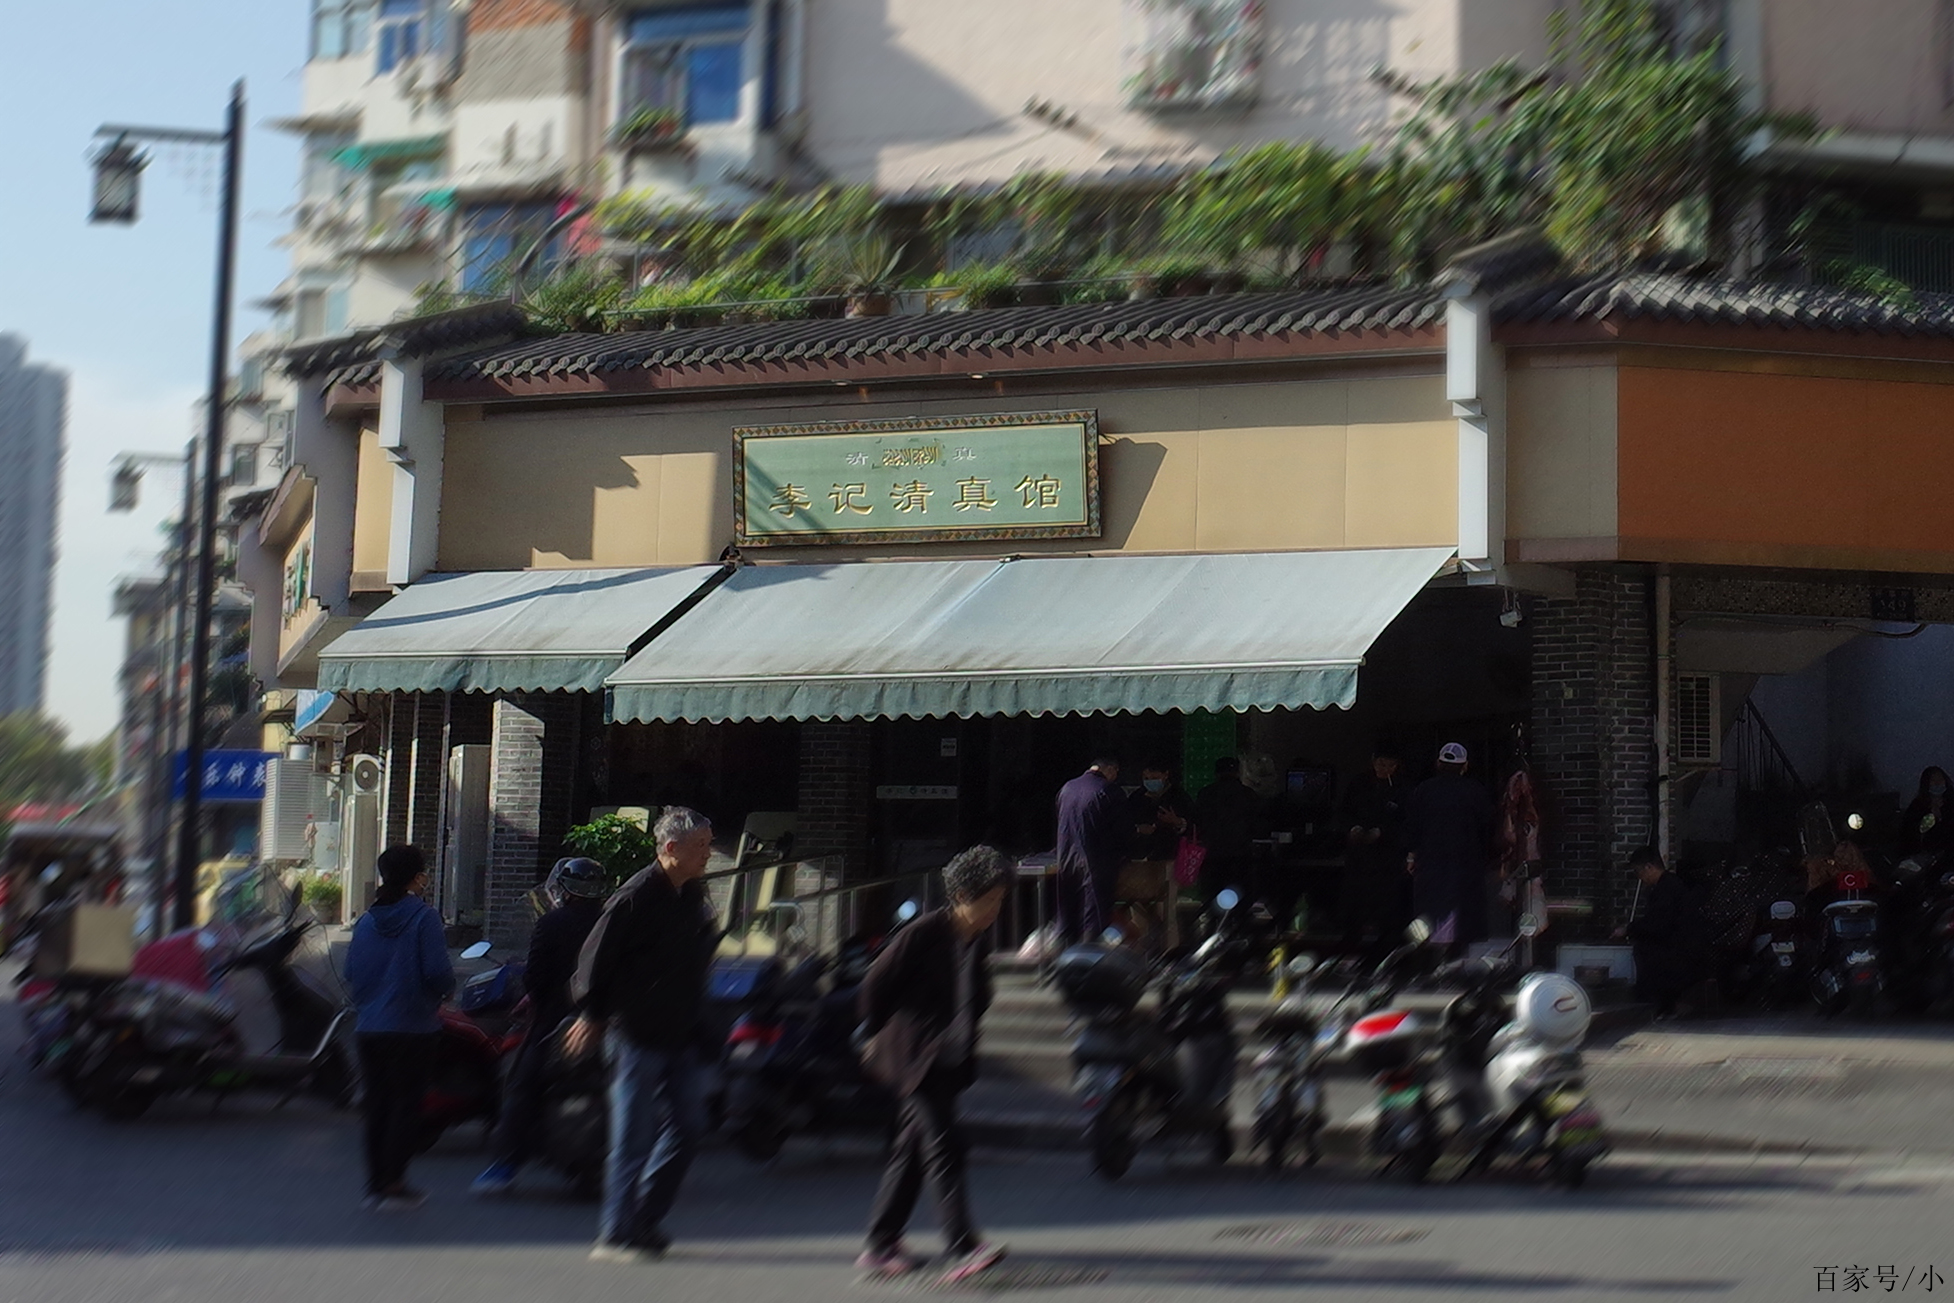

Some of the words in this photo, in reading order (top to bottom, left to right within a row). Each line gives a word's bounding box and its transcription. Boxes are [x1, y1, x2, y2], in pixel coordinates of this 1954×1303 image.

[769, 473, 1062, 519] 李记清真馆
